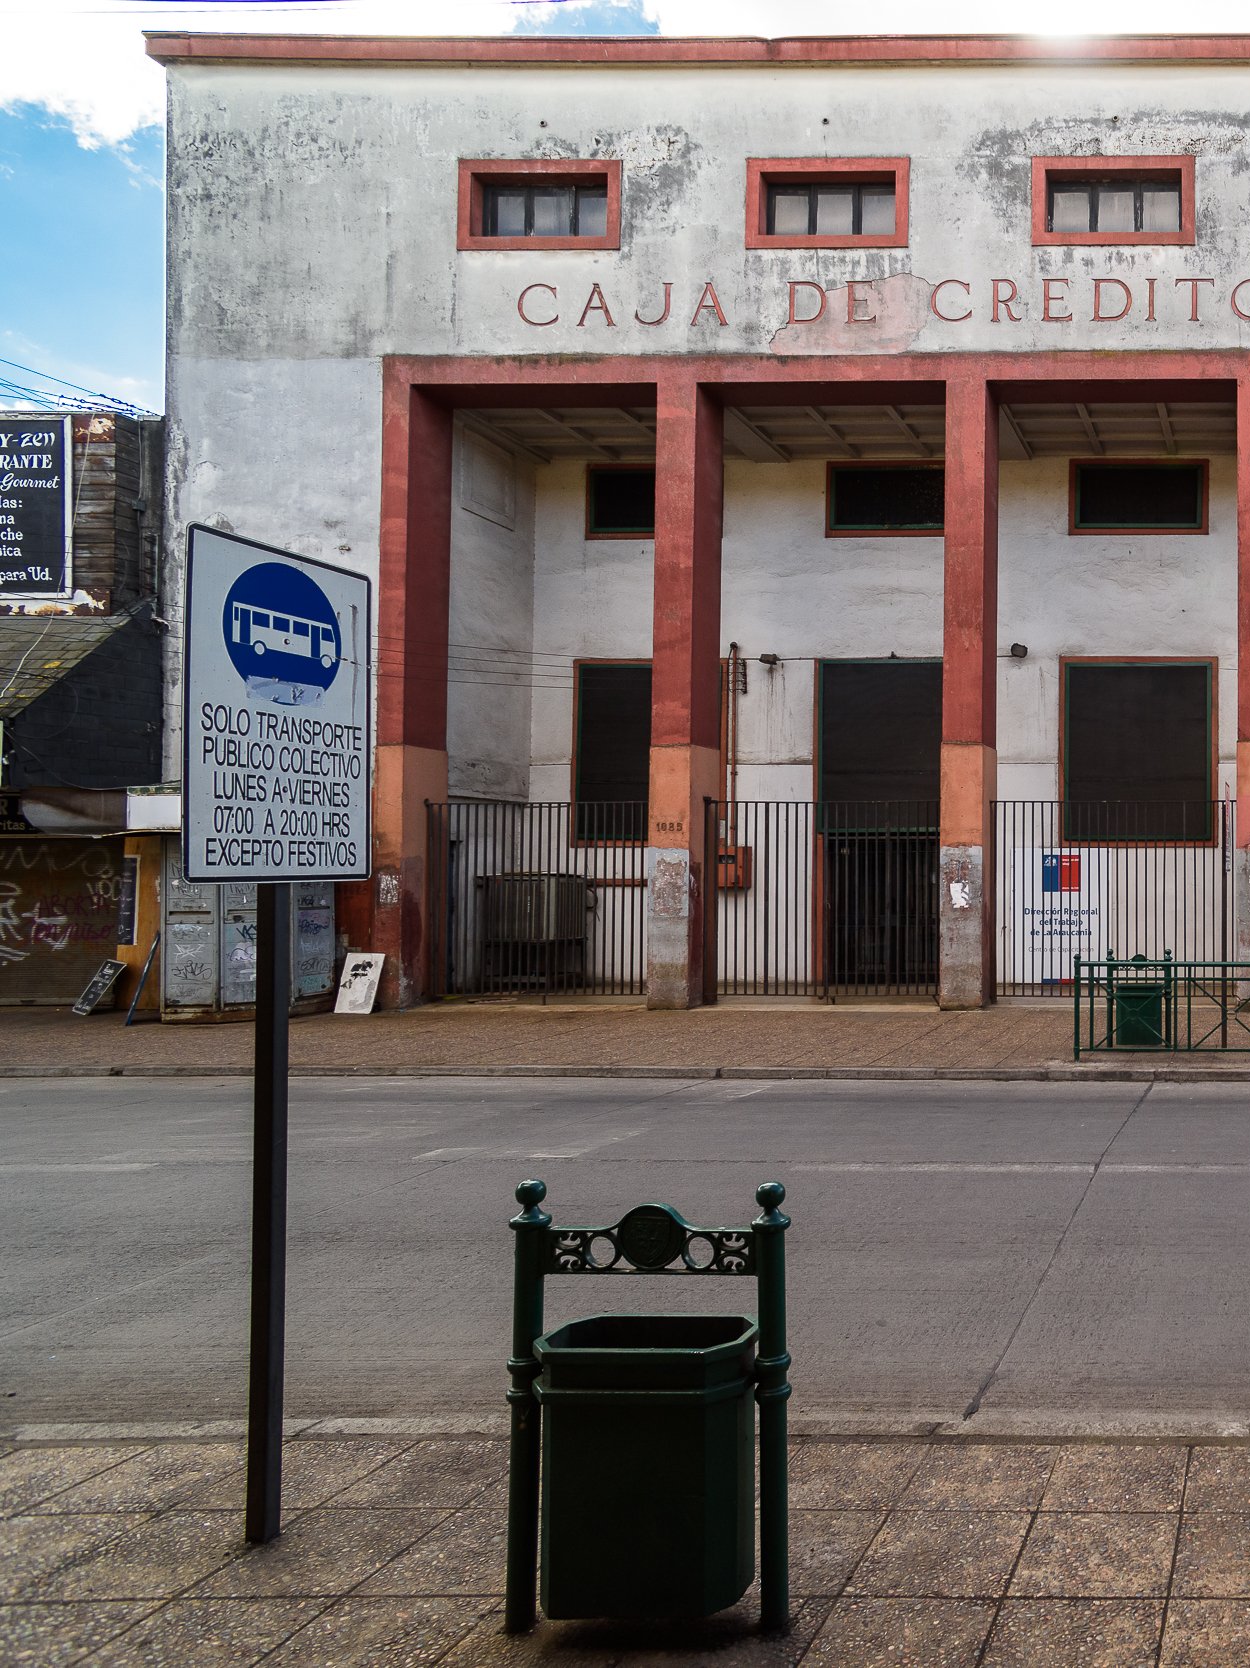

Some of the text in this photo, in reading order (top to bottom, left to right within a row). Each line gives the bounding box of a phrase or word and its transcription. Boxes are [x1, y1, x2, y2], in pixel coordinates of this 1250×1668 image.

[517, 281, 729, 327] CAJA
[786, 279, 877, 325] DE
[27, 566, 53, 581] Ud.
[201, 702, 362, 751] SOLO TRANSPORTE
[202, 736, 361, 779] PUBLICO COLECTIVO
[213, 770, 350, 808] LUNES A VIERNES
[213, 805, 350, 838] 07:00 A 20:00 HRS
[656, 822, 682, 831] 1085
[205, 837, 357, 867] EXCEPTO FESTIVOS
